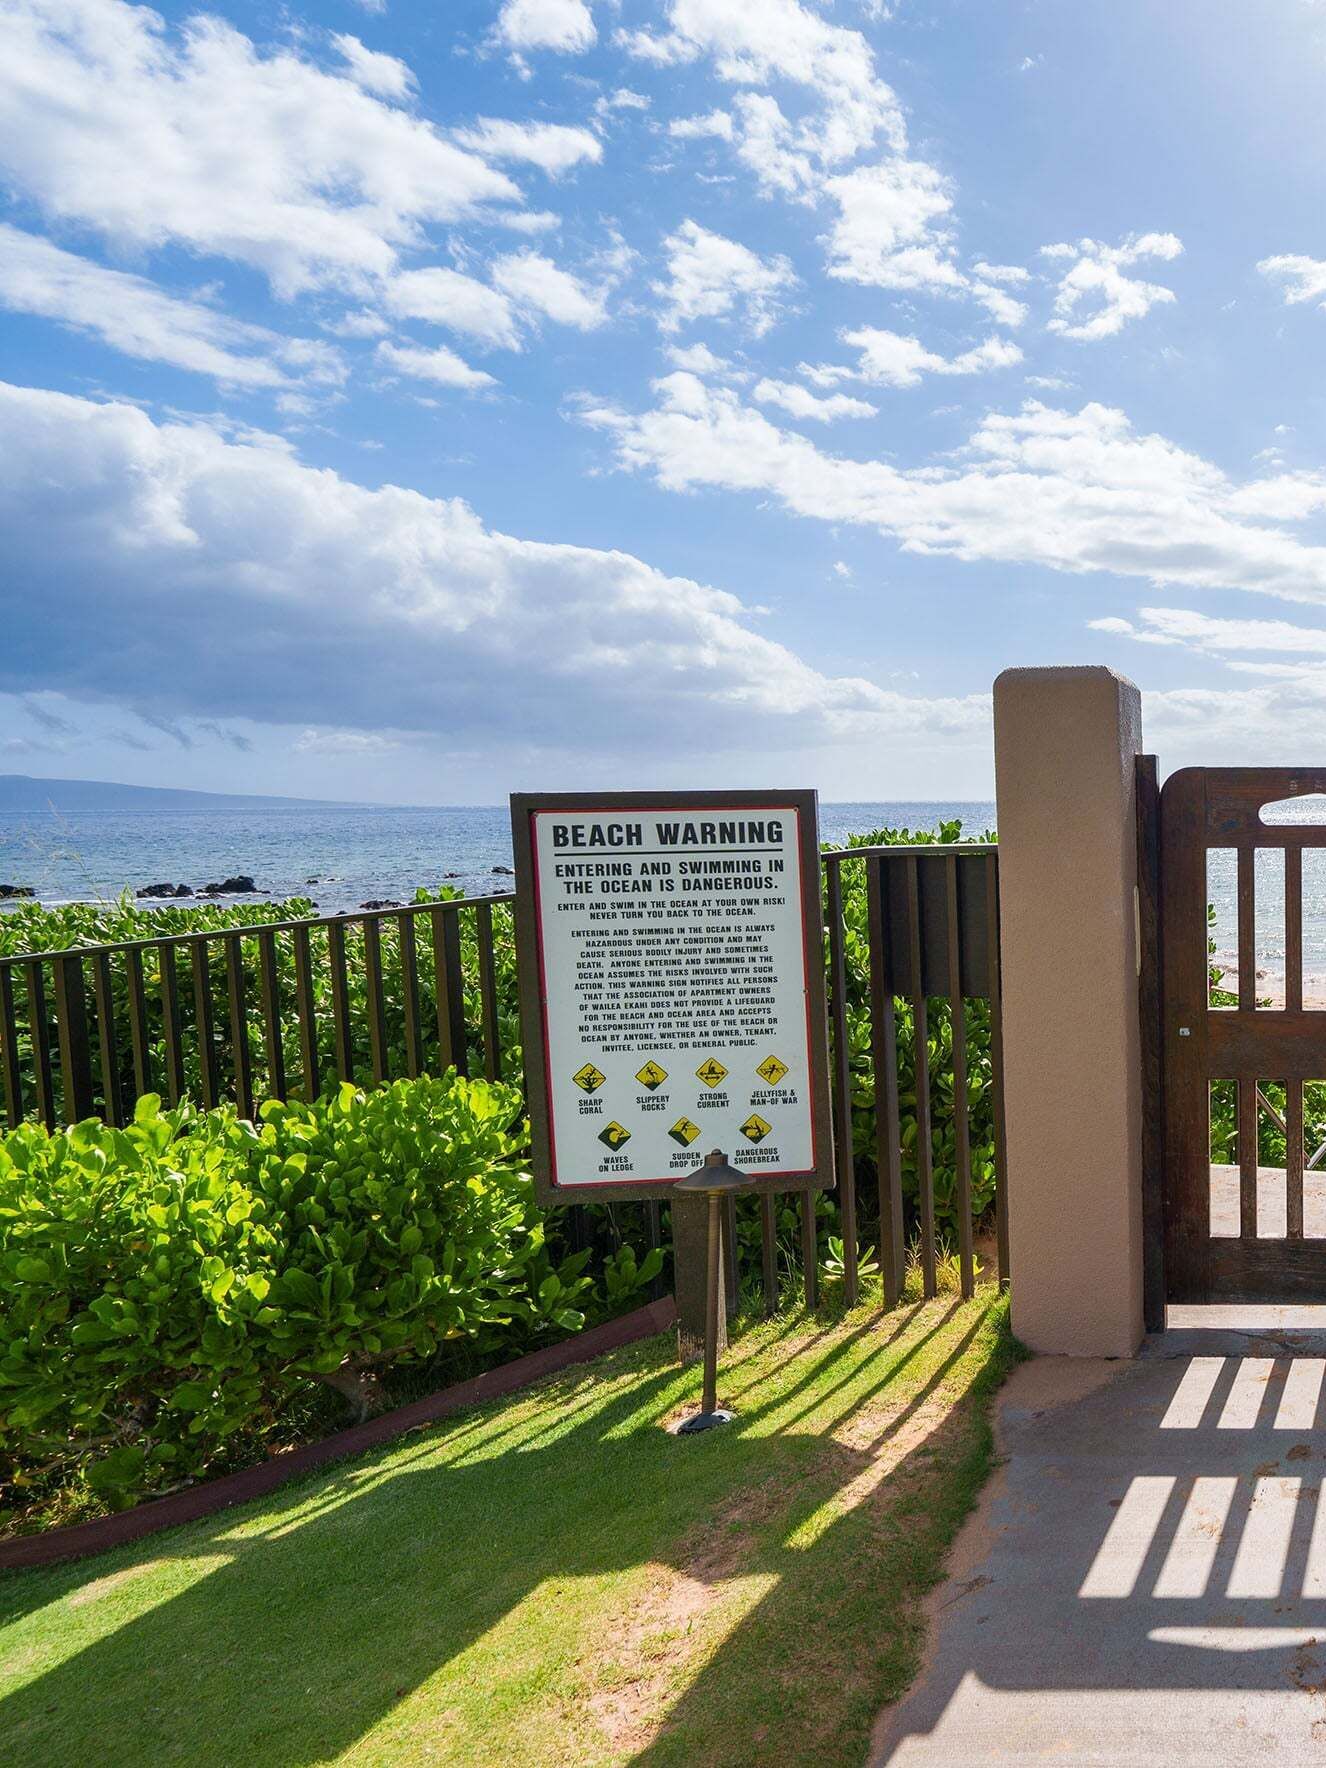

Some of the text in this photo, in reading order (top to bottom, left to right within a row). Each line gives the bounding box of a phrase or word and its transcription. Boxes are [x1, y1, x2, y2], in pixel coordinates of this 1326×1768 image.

[552, 820, 783, 848] BEACH WARNING
[554, 859, 784, 878] ENTERING AND SWIMMING IN
[562, 875, 778, 894] THE OCEAN IS DANGEROUS.
[557, 902, 585, 911] ENTER
[588, 901, 606, 910] AND
[609, 900, 634, 909] SWIM
[637, 900, 647, 909] IN
[650, 900, 666, 908] THE
[669, 899, 698, 908] OCEAN
[700, 898, 712, 907] AT
[714, 898, 737, 907] YOUR
[740, 897, 760, 906] OWN
[589, 907, 756, 920] NEVER TURN YOU BACK TO THE OCEAN.
[570, 928, 610, 937] ENTERING
[612, 928, 629, 936] AND
[631, 927, 674, 936] SWIMMING
[687, 926, 703, 934] THE
[705, 925, 731, 933] OCEAN
[744, 924, 775, 932] ALWAYS
[585, 934, 762, 948] HAZARDOUS UNDER ANY CONDITION AND MAY
[580, 944, 768, 958] CAUSE SERIOUS BODILY INJURY AND SOMETIMES
[576, 955, 773, 969] DEATH. ANYONE ENTERING AND SWIMMING IN THE
[577, 965, 773, 980] OCEAN ASSUMES THE RISKS INVOLVED WITH SUCH
[574, 975, 778, 990] ACTION. THIS WARNING SIGN NOTIFIES ALL PERSONS
[582, 986, 771, 1000] THAT THE ASSOCIATION OF APARTMENT OWNERS
[578, 1003, 588, 1011] OF
[591, 1002, 621, 1011] WAILEA
[623, 1001, 648, 1009] EKAHI
[650, 1000, 670, 1008] DOES
[673, 999, 689, 1007] NOT
[691, 998, 723, 1007] PROVIDE
[734, 996, 775, 1005] LIFEGUARD
[583, 1006, 772, 1022] FOR THE BEACH AND OCEAN AREA AND ACCEPTS
[578, 1024, 590, 1032] NO
[592, 1021, 655, 1032] RESPONSIBILITY
[657, 1021, 672, 1029] FOR
[675, 1020, 690, 1028] THE
[692, 1019, 707, 1028] USE
[710, 1019, 720, 1027] OF
[722, 1018, 737, 1026] THE
[740, 1017, 765, 1026] BEACH
[580, 1034, 607, 1042] OCEAN
[622, 1032, 656, 1041] ANYONE,
[659, 1030, 696, 1040] WHETHER
[712, 1028, 742, 1038] OWNER,
[744, 1027, 776, 1036] TENANT,
[601, 1038, 757, 1053] INVITEE, LICENSEE, OR GENERAL PUBLIC.
[635, 1094, 670, 1104] SLIPPERY
[698, 1091, 727, 1101] STRONG
[751, 1088, 795, 1098] JELLYFISH &
[578, 1097, 603, 1107] SHARP
[640, 1102, 666, 1112] ROCKS
[696, 1099, 730, 1109] CURRENT
[749, 1096, 798, 1106] MAN-OF WAR
[578, 1106, 603, 1114] CORAL
[671, 1151, 700, 1160] SUDDEN
[735, 1146, 778, 1157] DANGEROUS
[603, 1155, 628, 1164] WAVES
[669, 1158, 703, 1168] DROP OFF
[733, 1154, 780, 1165] SHOREBREAK
[598, 1162, 633, 1172] ON LEDGE
